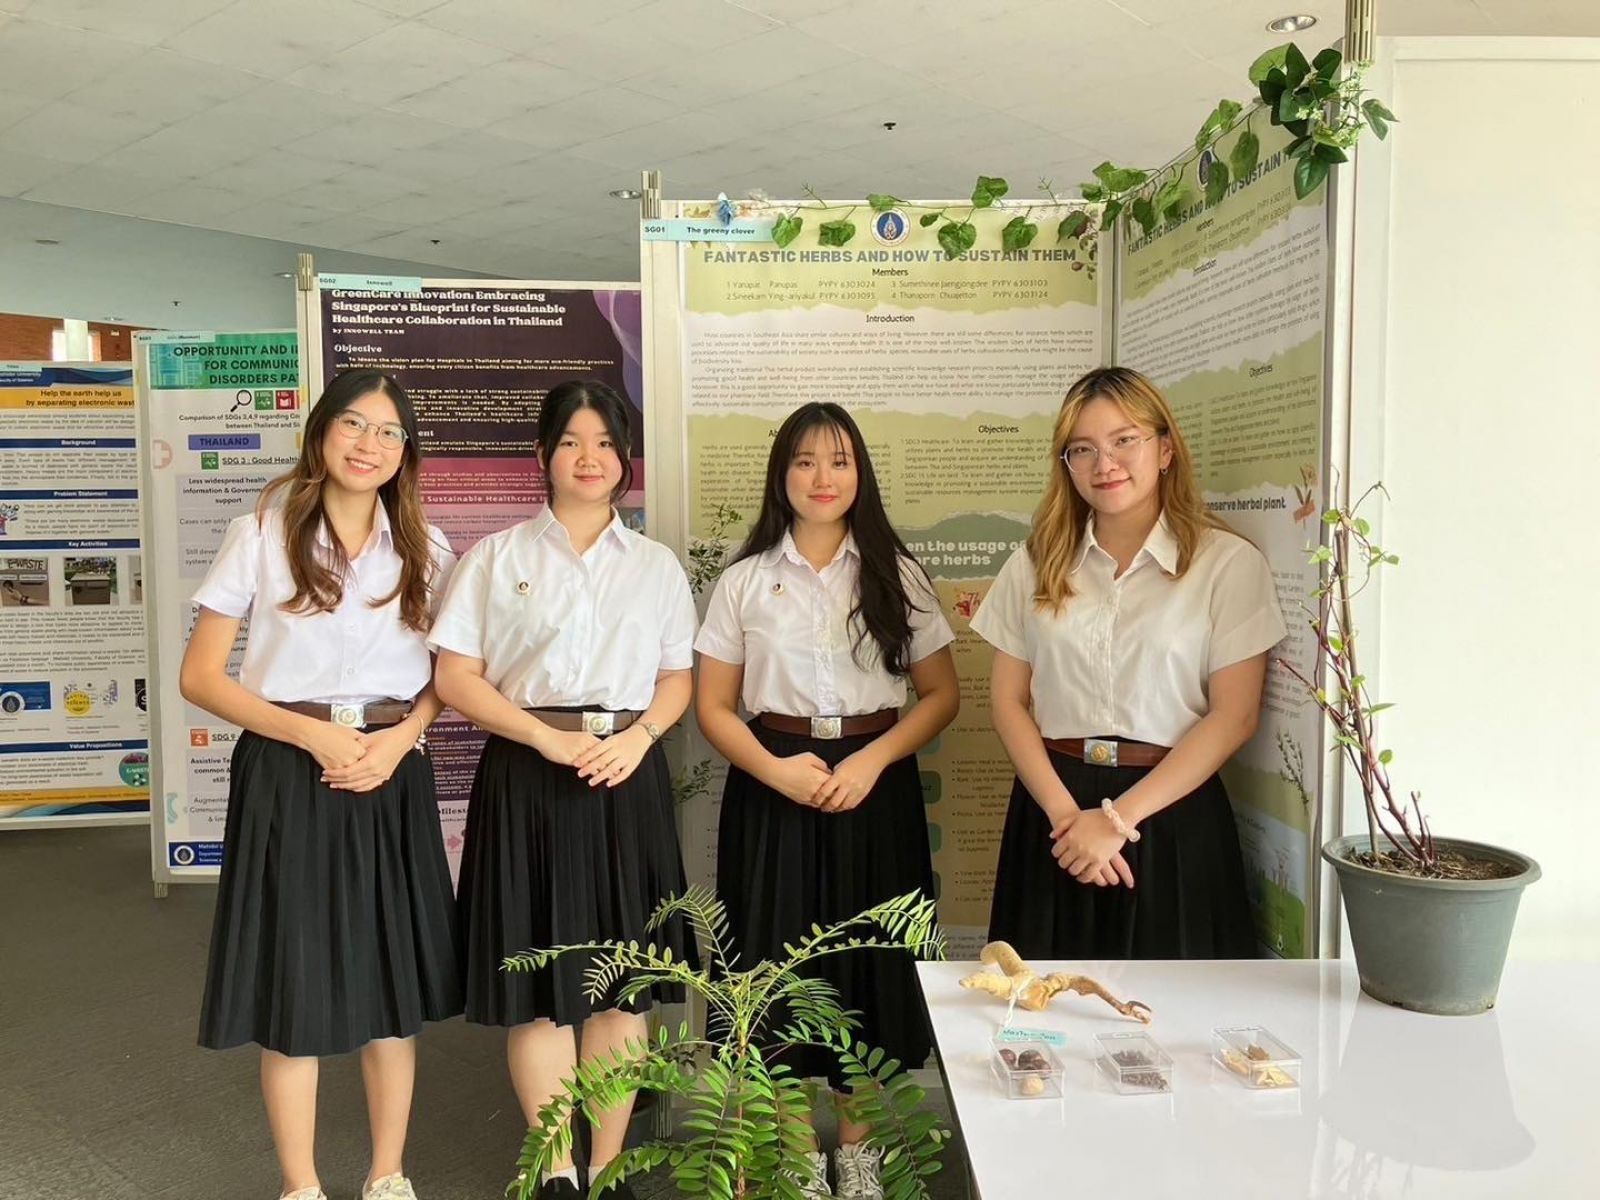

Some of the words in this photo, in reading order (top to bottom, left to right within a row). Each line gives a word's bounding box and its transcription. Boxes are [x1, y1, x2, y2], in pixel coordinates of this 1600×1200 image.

[686, 226, 701, 234] The
[703, 226, 730, 236] greeny
[703, 250, 797, 263] FANTASTIC
[799, 250, 853, 263] HERBS
[856, 250, 889, 263] AND
[892, 250, 930, 262] HOW
[958, 249, 1031, 262] SUSTAIN
[1031, 249, 1076, 261] THEM
[871, 268, 909, 277] Members
[331, 289, 402, 299] GreenCare
[476, 291, 546, 302] Embracing
[331, 301, 408, 313] Singapore's
[409, 302, 469, 314] Blueprint
[470, 303, 491, 313] for
[492, 303, 566, 314] Sustainable
[332, 314, 404, 324] Healthcare
[405, 315, 491, 326] Collaboration
[493, 316, 506, 326] in
[507, 317, 563, 327] Thailand
[866, 314, 915, 324] Introduction
[173, 345, 259, 357] OPPORTUNITY
[260, 345, 288, 355] AND
[334, 344, 383, 353] Objective
[204, 360, 228, 370] FOR
[209, 373, 278, 384] DISORDERS
[978, 425, 1020, 434] Objectives
[200, 437, 250, 447] THAILAND
[222, 457, 239, 465] SDG
[252, 456, 273, 465] Good
[204, 478, 244, 486] widespread
[427, 495, 482, 503] Sustainable
[486, 495, 539, 503] Healthcare
[1206, 500, 1236, 512] nserve
[1237, 497, 1263, 511] herbal
[908, 541, 924, 551] en
[927, 540, 957, 551] the
[958, 541, 1007, 555] usage
[943, 554, 992, 565] herbs
